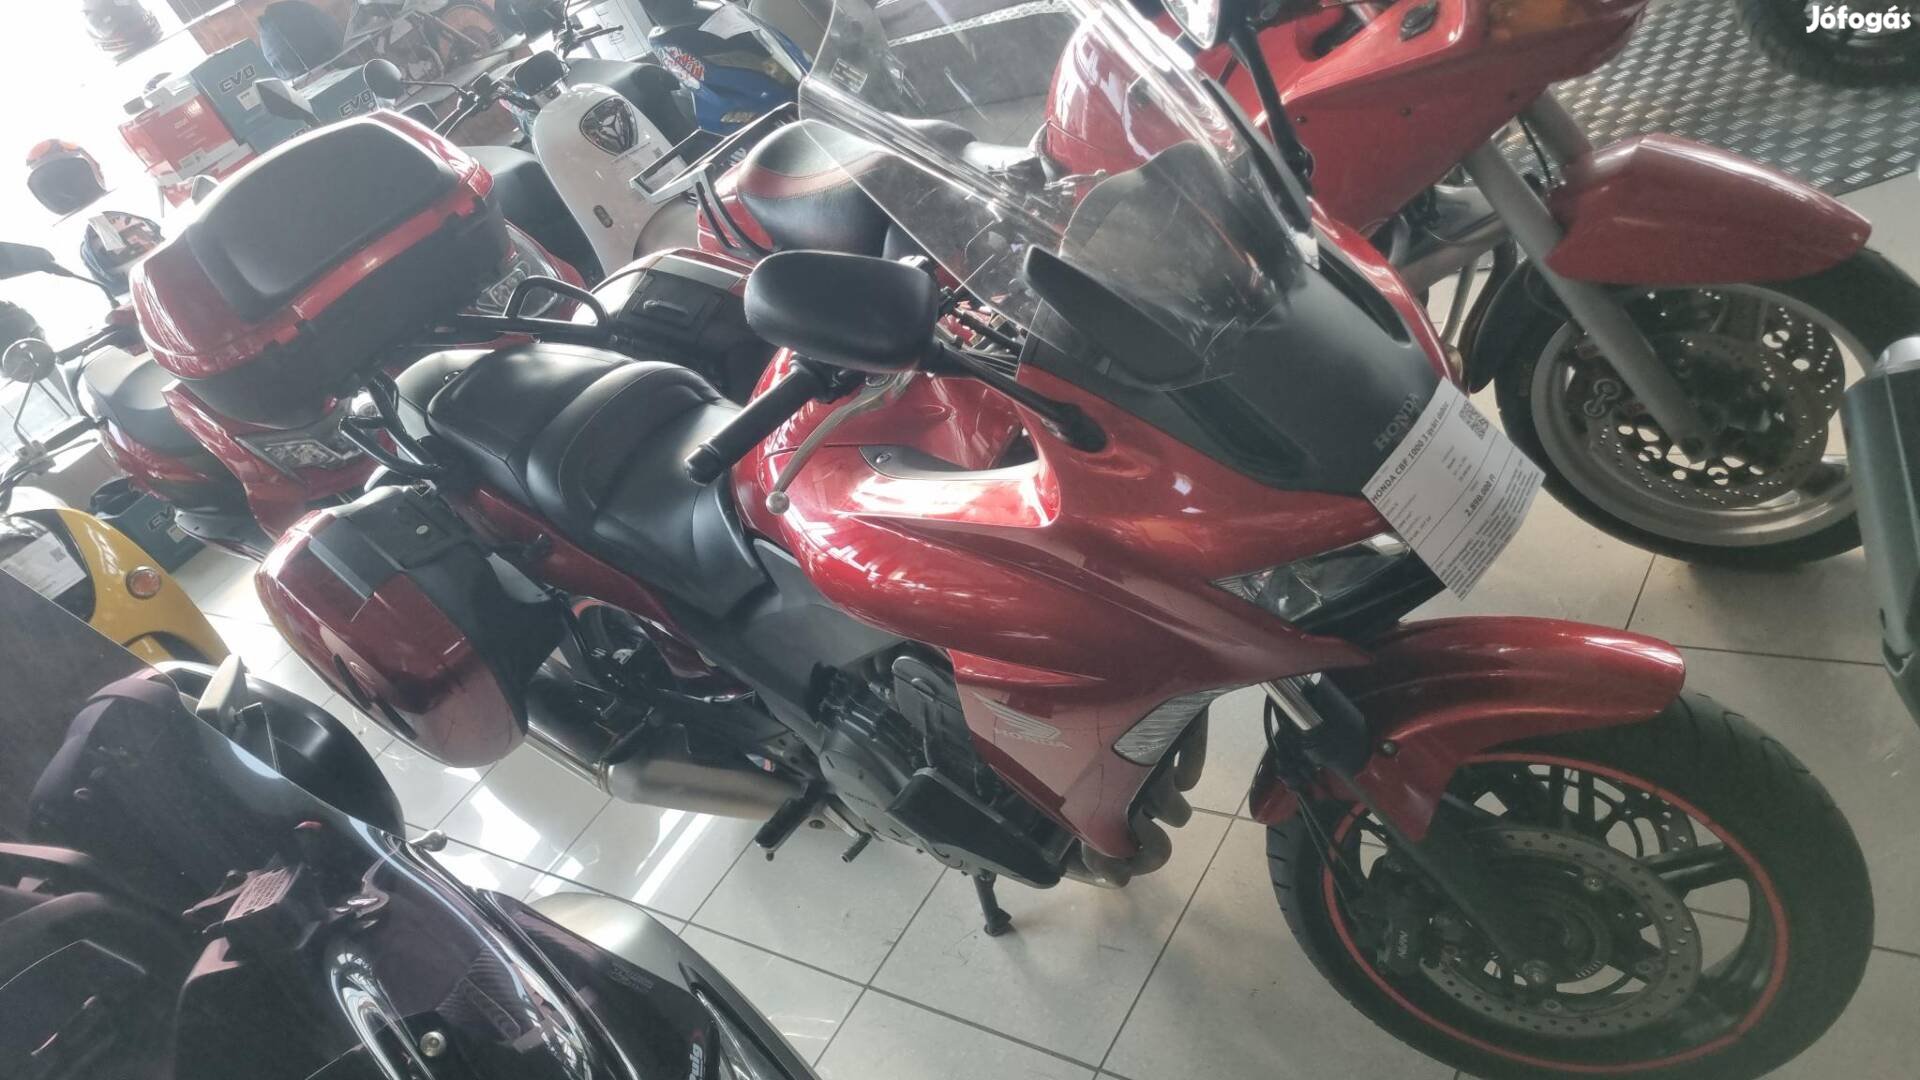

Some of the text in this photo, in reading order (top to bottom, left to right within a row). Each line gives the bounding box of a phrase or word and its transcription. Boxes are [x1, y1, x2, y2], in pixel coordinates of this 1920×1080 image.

[1374, 392, 1420, 451] HONDA
[1372, 475, 1397, 503] HONDA
[1395, 458, 1409, 476] CBF
[1408, 439, 1425, 460] 1000
